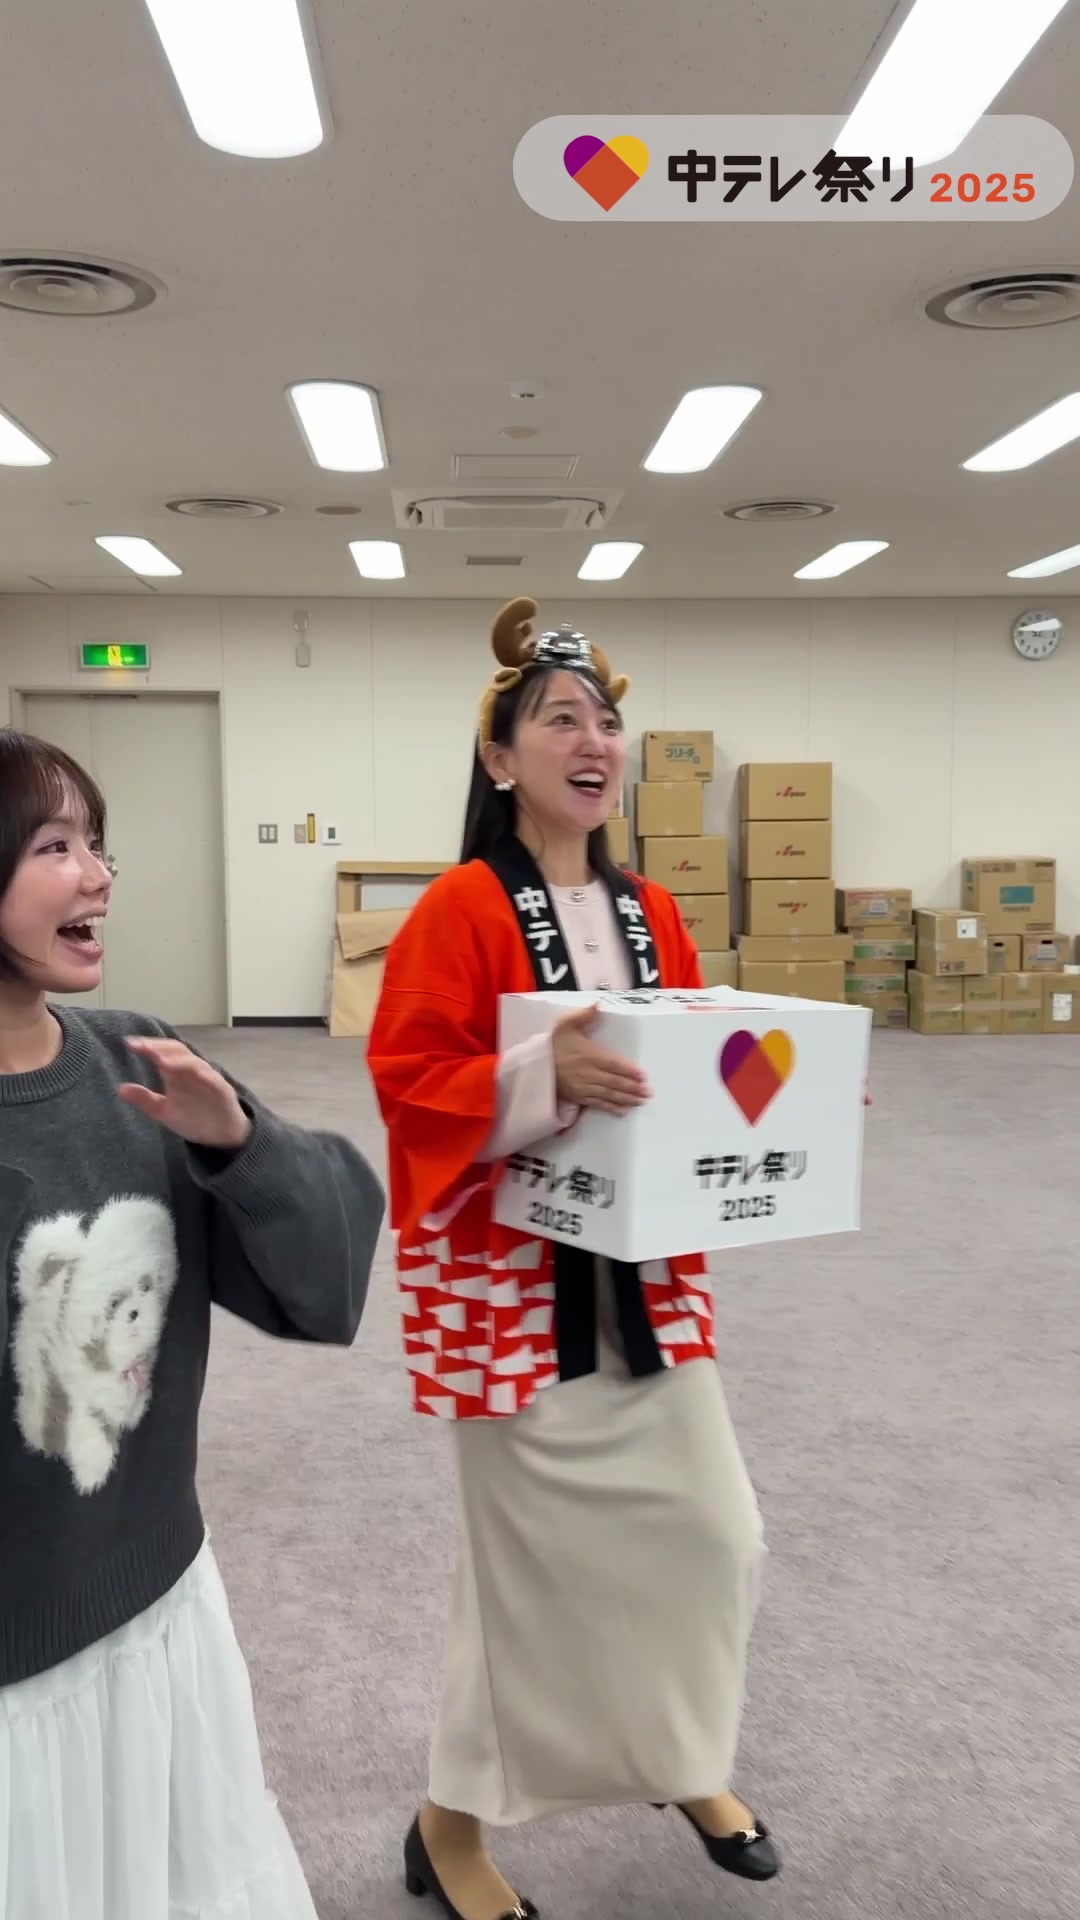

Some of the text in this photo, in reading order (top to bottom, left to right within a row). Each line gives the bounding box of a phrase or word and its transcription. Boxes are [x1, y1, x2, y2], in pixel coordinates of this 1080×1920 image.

[513, 886, 568, 984] 中テレ
[615, 894, 659, 983] 中テレ
[527, 1201, 583, 1236] 2025
[718, 1195, 776, 1221] 2025
